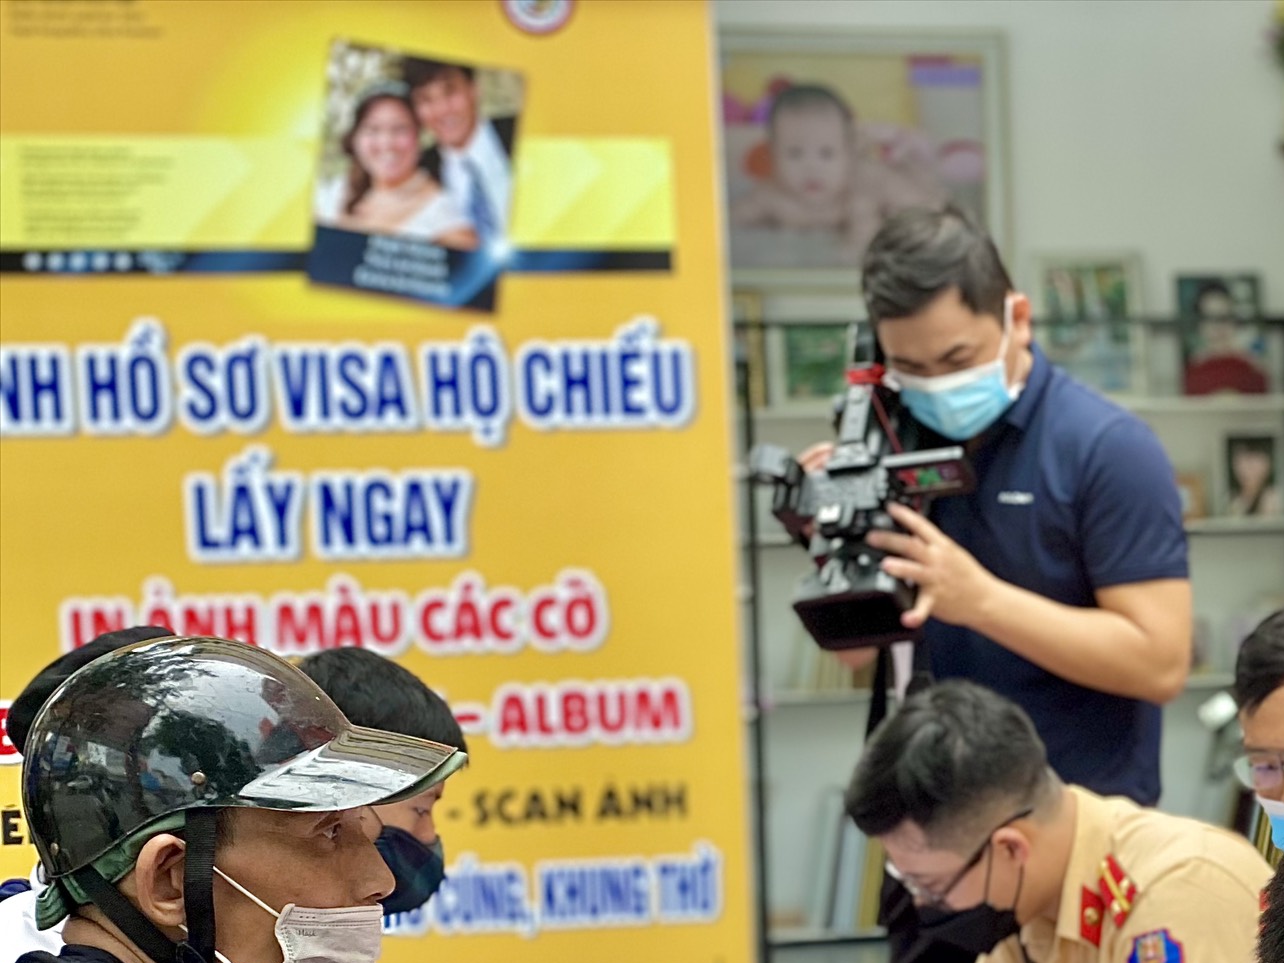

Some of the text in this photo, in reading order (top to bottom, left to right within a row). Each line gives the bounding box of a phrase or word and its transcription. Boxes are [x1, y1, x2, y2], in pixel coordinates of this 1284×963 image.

[185, 344, 259, 421] SƠ
[280, 352, 407, 420] VISA
[428, 335, 499, 437] HỘ
[523, 324, 683, 418] CHIẾU
[194, 452, 461, 549] LẤY NGAY
[420, 580, 516, 643] CÁC
[531, 577, 597, 640] CỠ
[500, 688, 682, 737] ALBUM
[474, 786, 582, 828] SCAN
